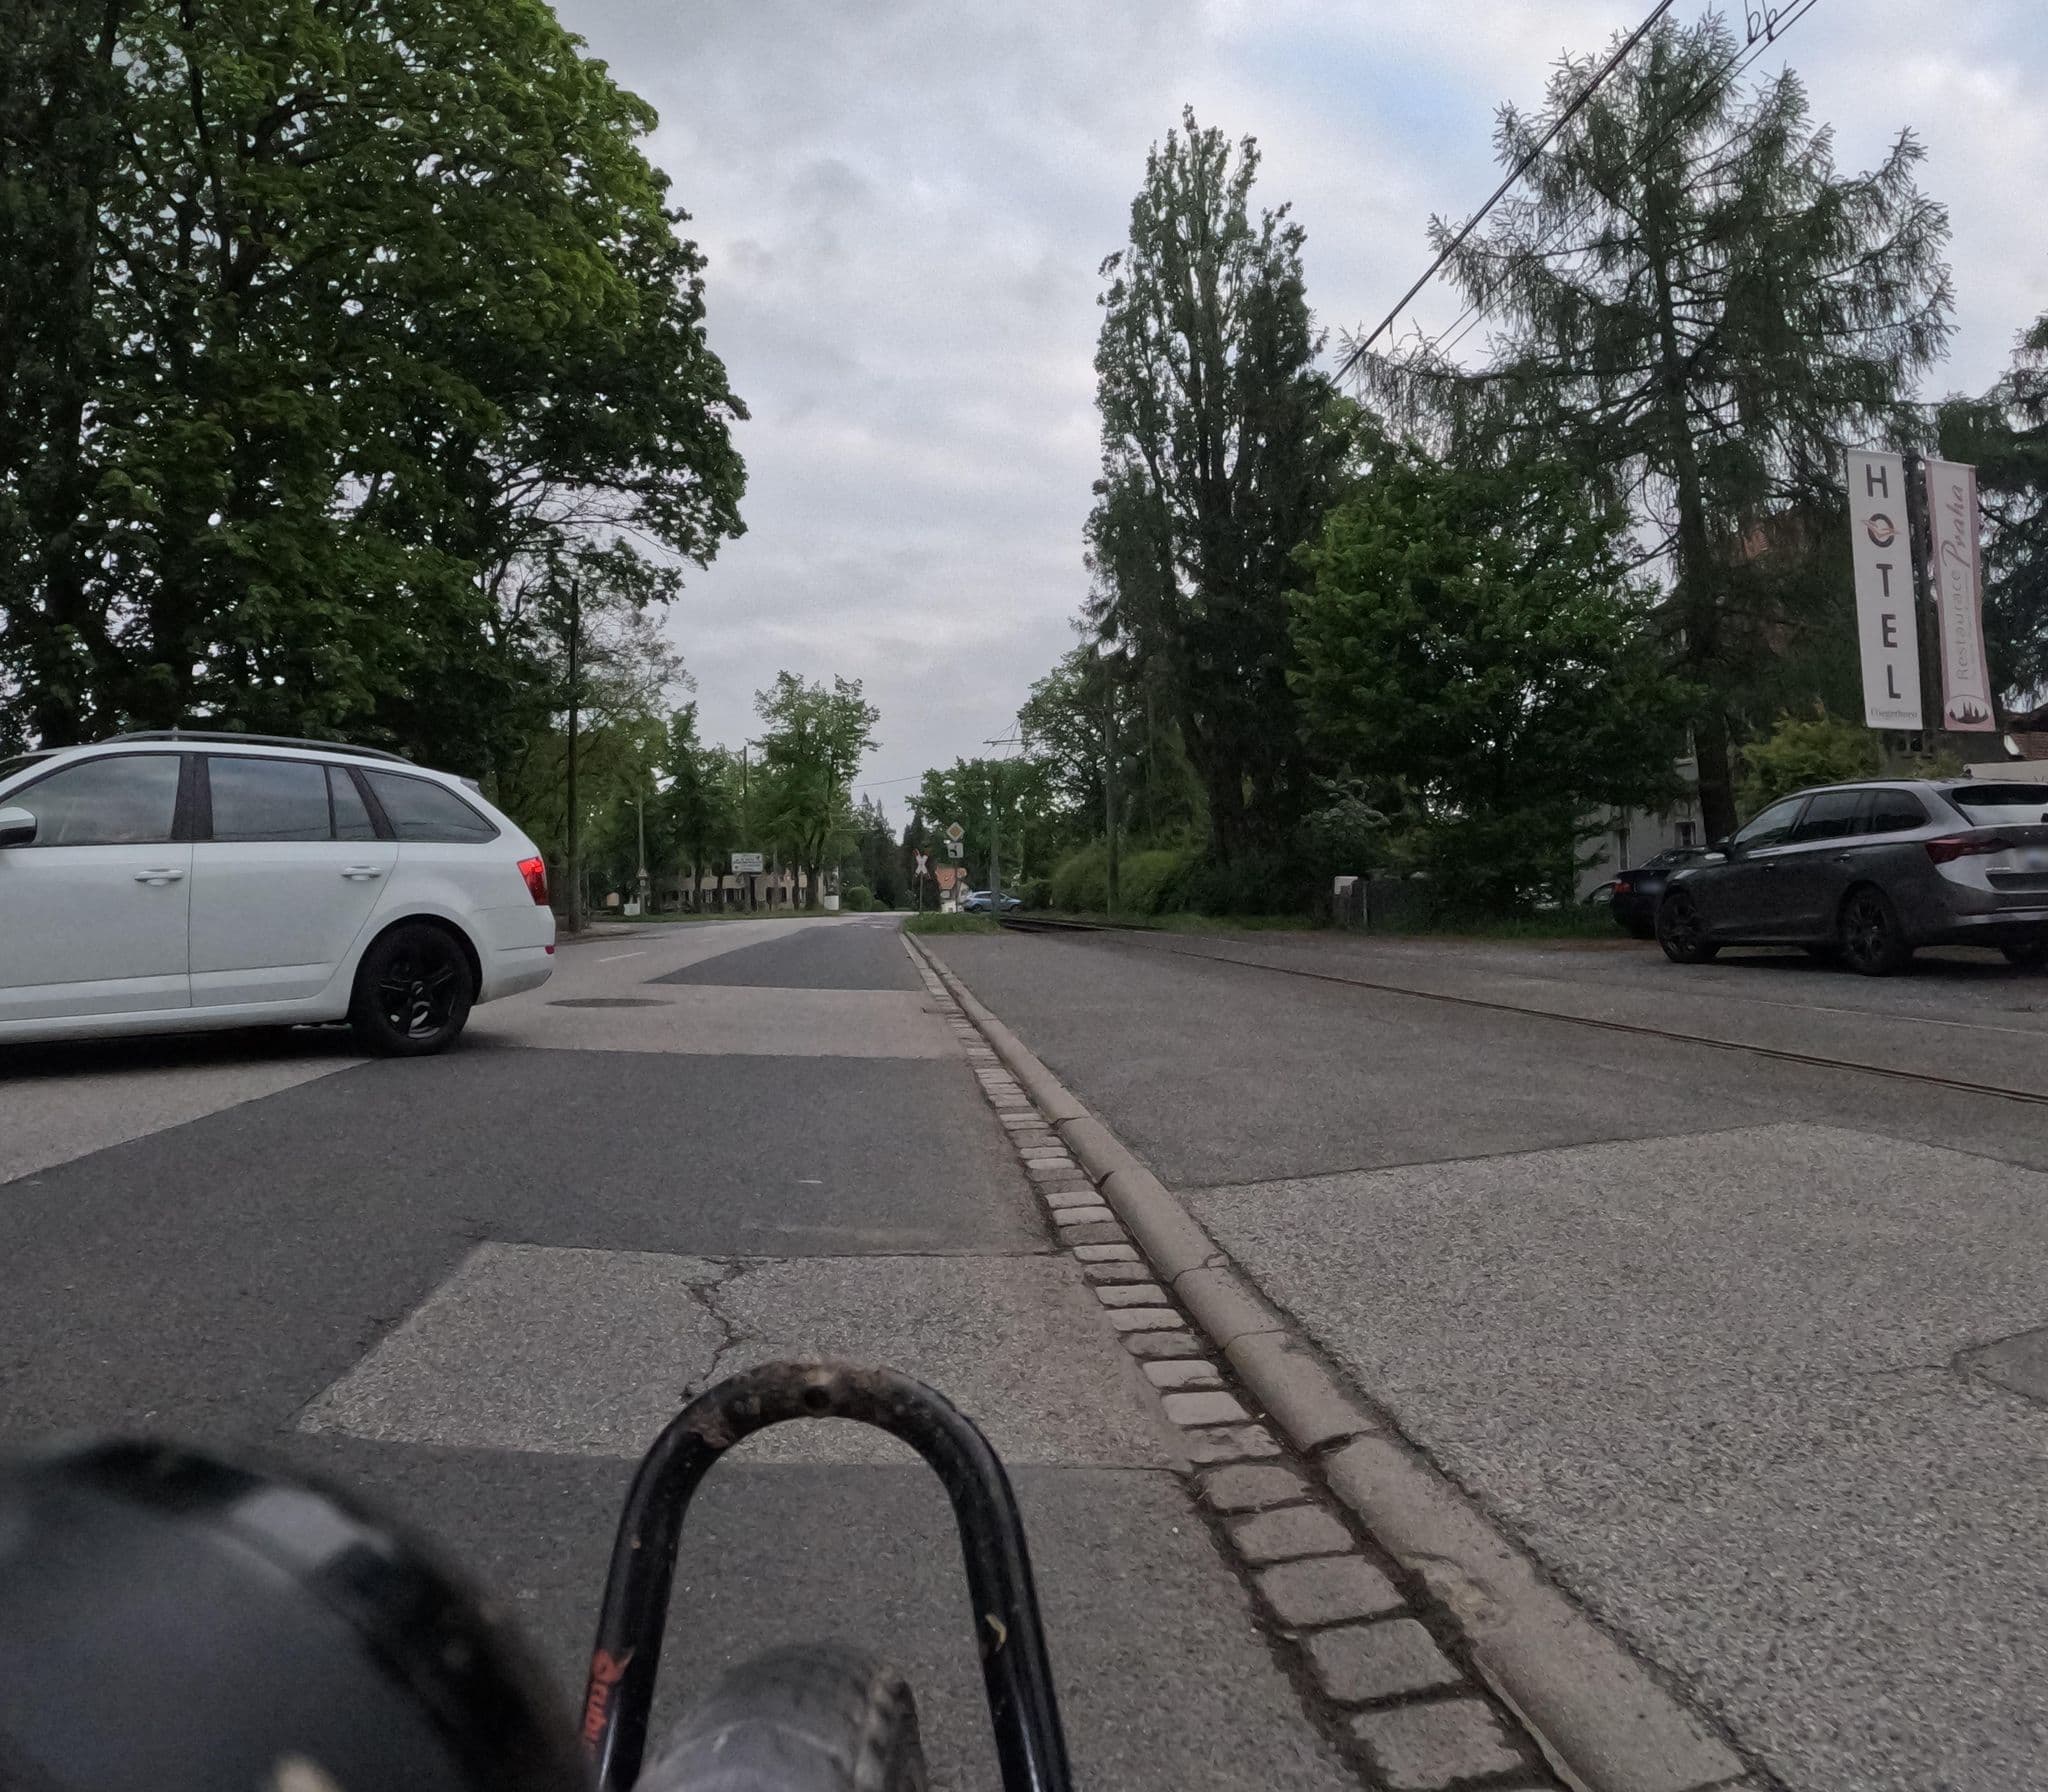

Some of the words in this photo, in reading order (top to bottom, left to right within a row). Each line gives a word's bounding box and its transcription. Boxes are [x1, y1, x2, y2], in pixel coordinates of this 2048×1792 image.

[1865, 463, 1902, 700] HOTEL
[1941, 484, 1971, 569] Praha
[1950, 571, 1969, 681] Restaurace
